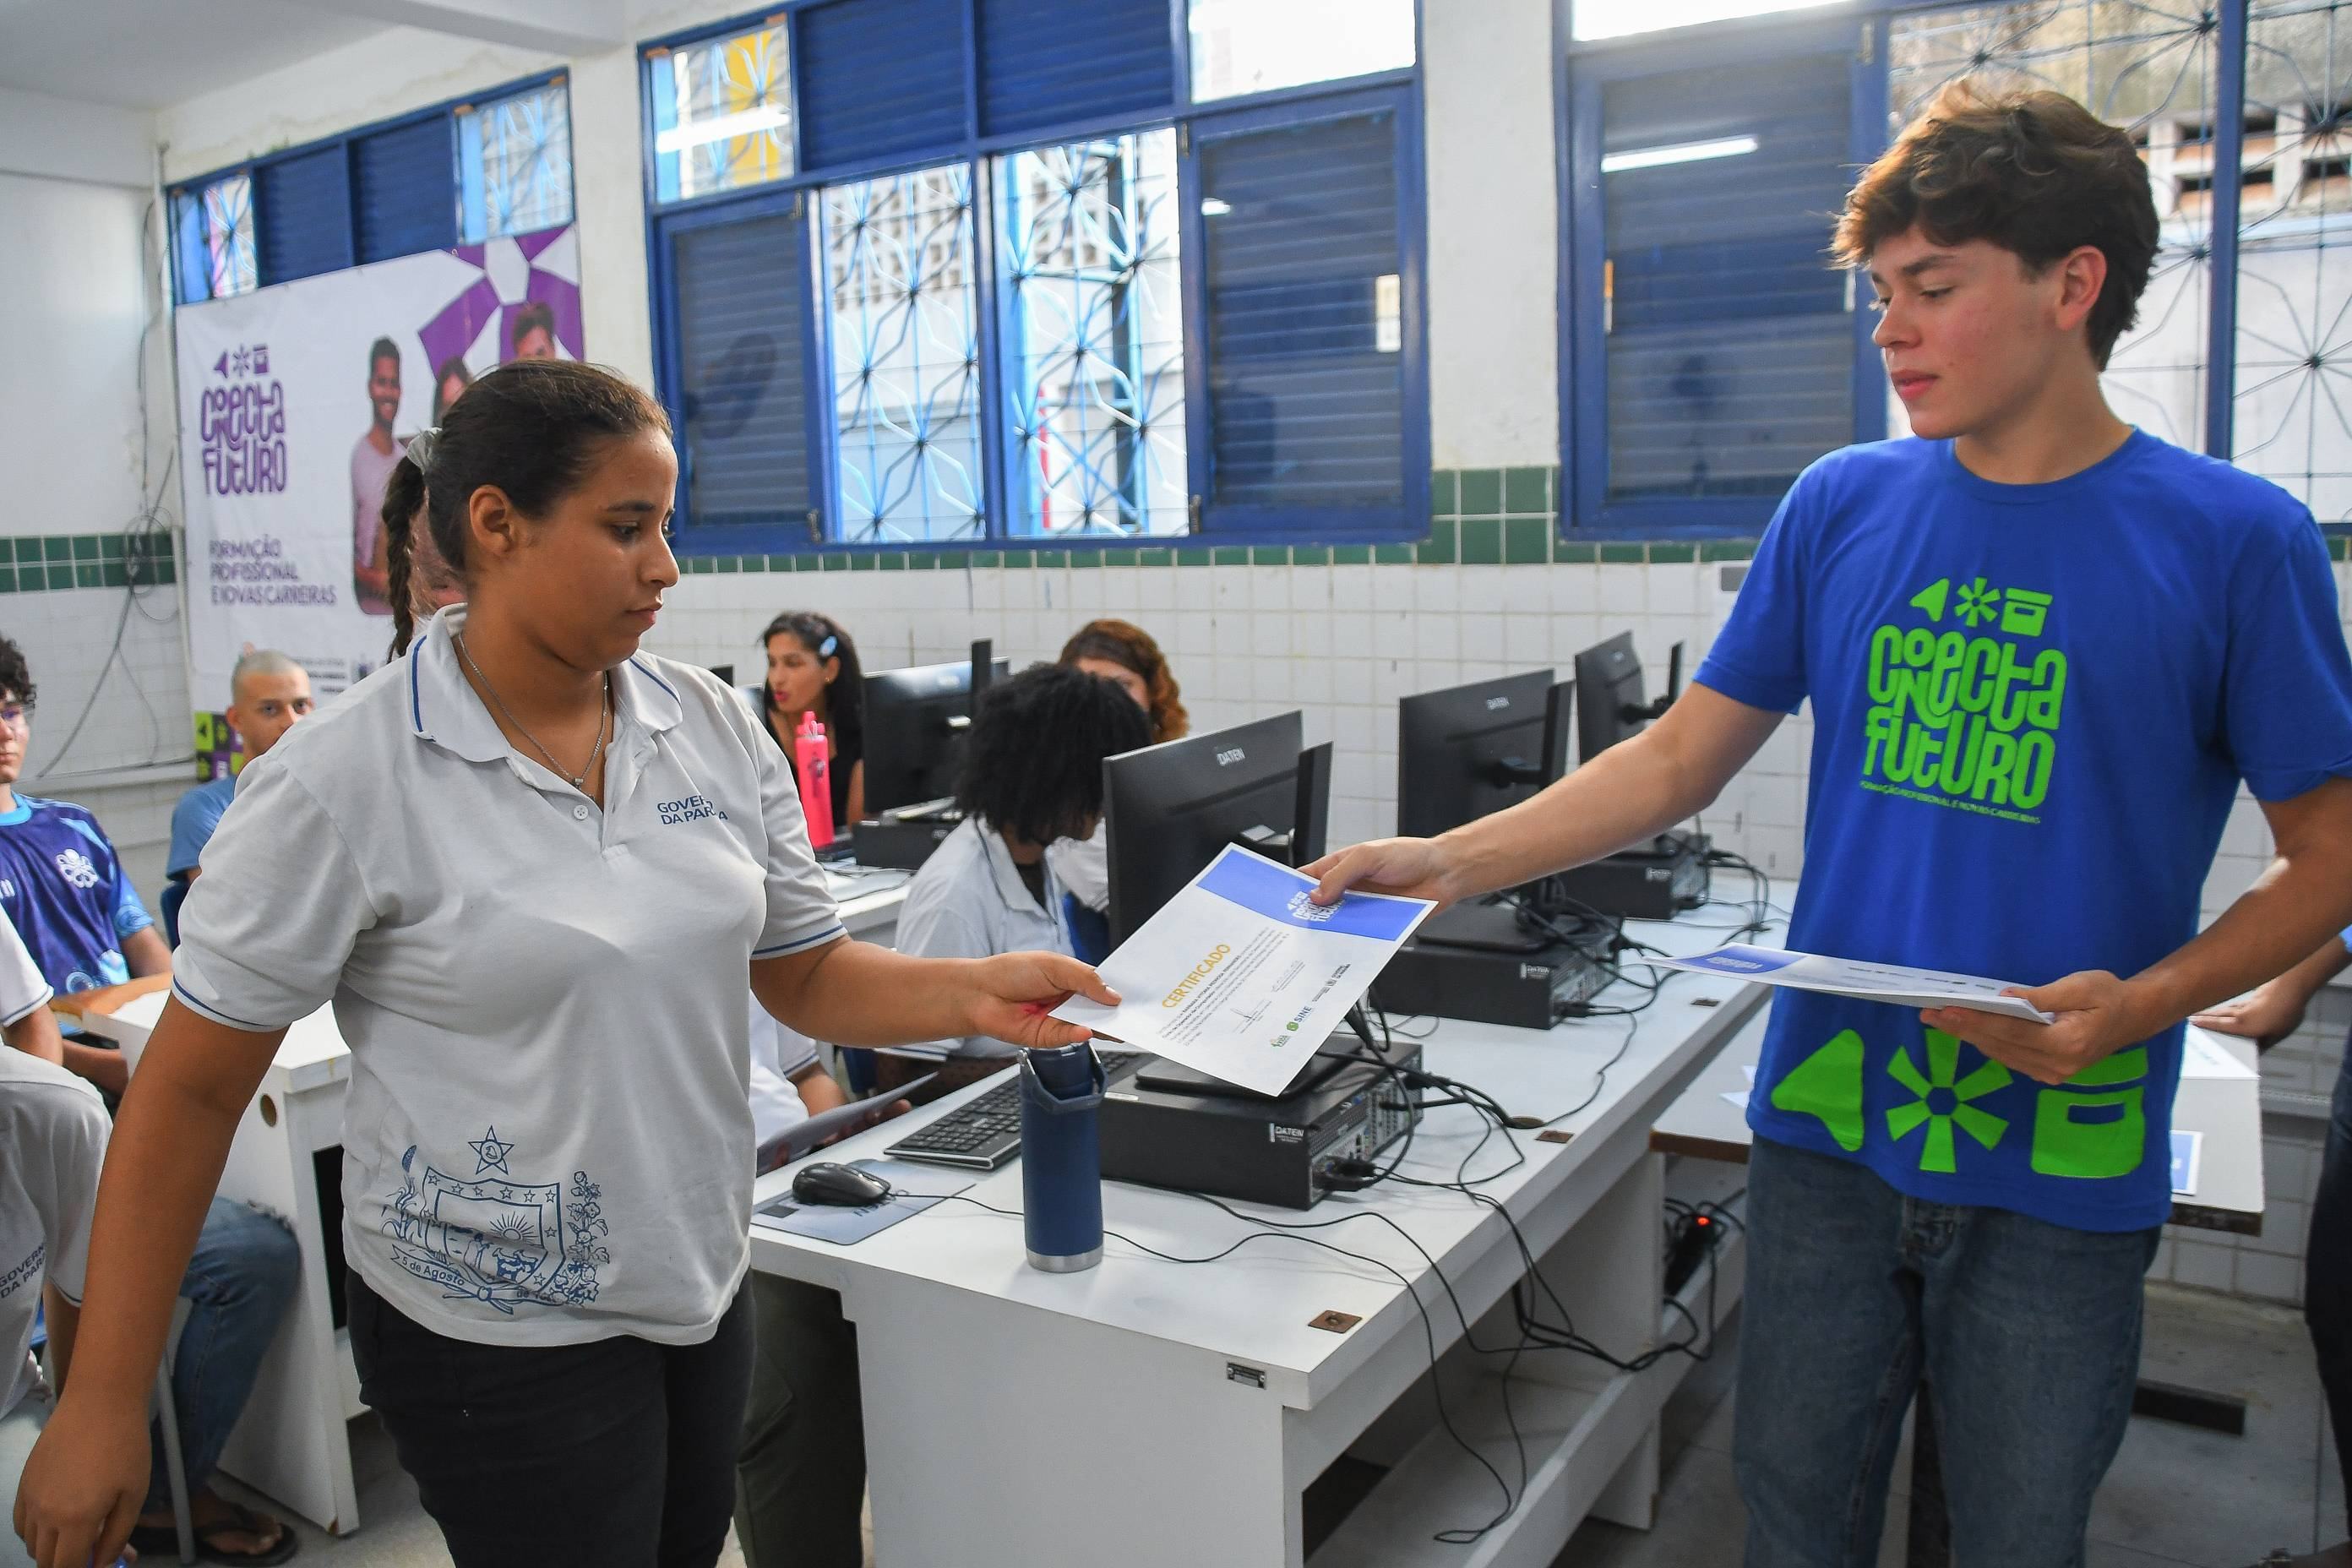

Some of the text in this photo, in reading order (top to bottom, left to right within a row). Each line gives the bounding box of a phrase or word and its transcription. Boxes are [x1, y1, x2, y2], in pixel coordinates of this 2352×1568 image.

[1217, 748, 1245, 766] DATEN
[661, 813, 683, 825] DA
[1162, 944, 1231, 1008] CERTIFICADO
[1294, 1006, 1312, 1022] SINE
[1275, 1125, 1304, 1137] DATEN
[0, 1244, 44, 1287] GOVERN
[401, 1256, 465, 1286] 5 de Agosto
[1, 1281, 20, 1298] DA
